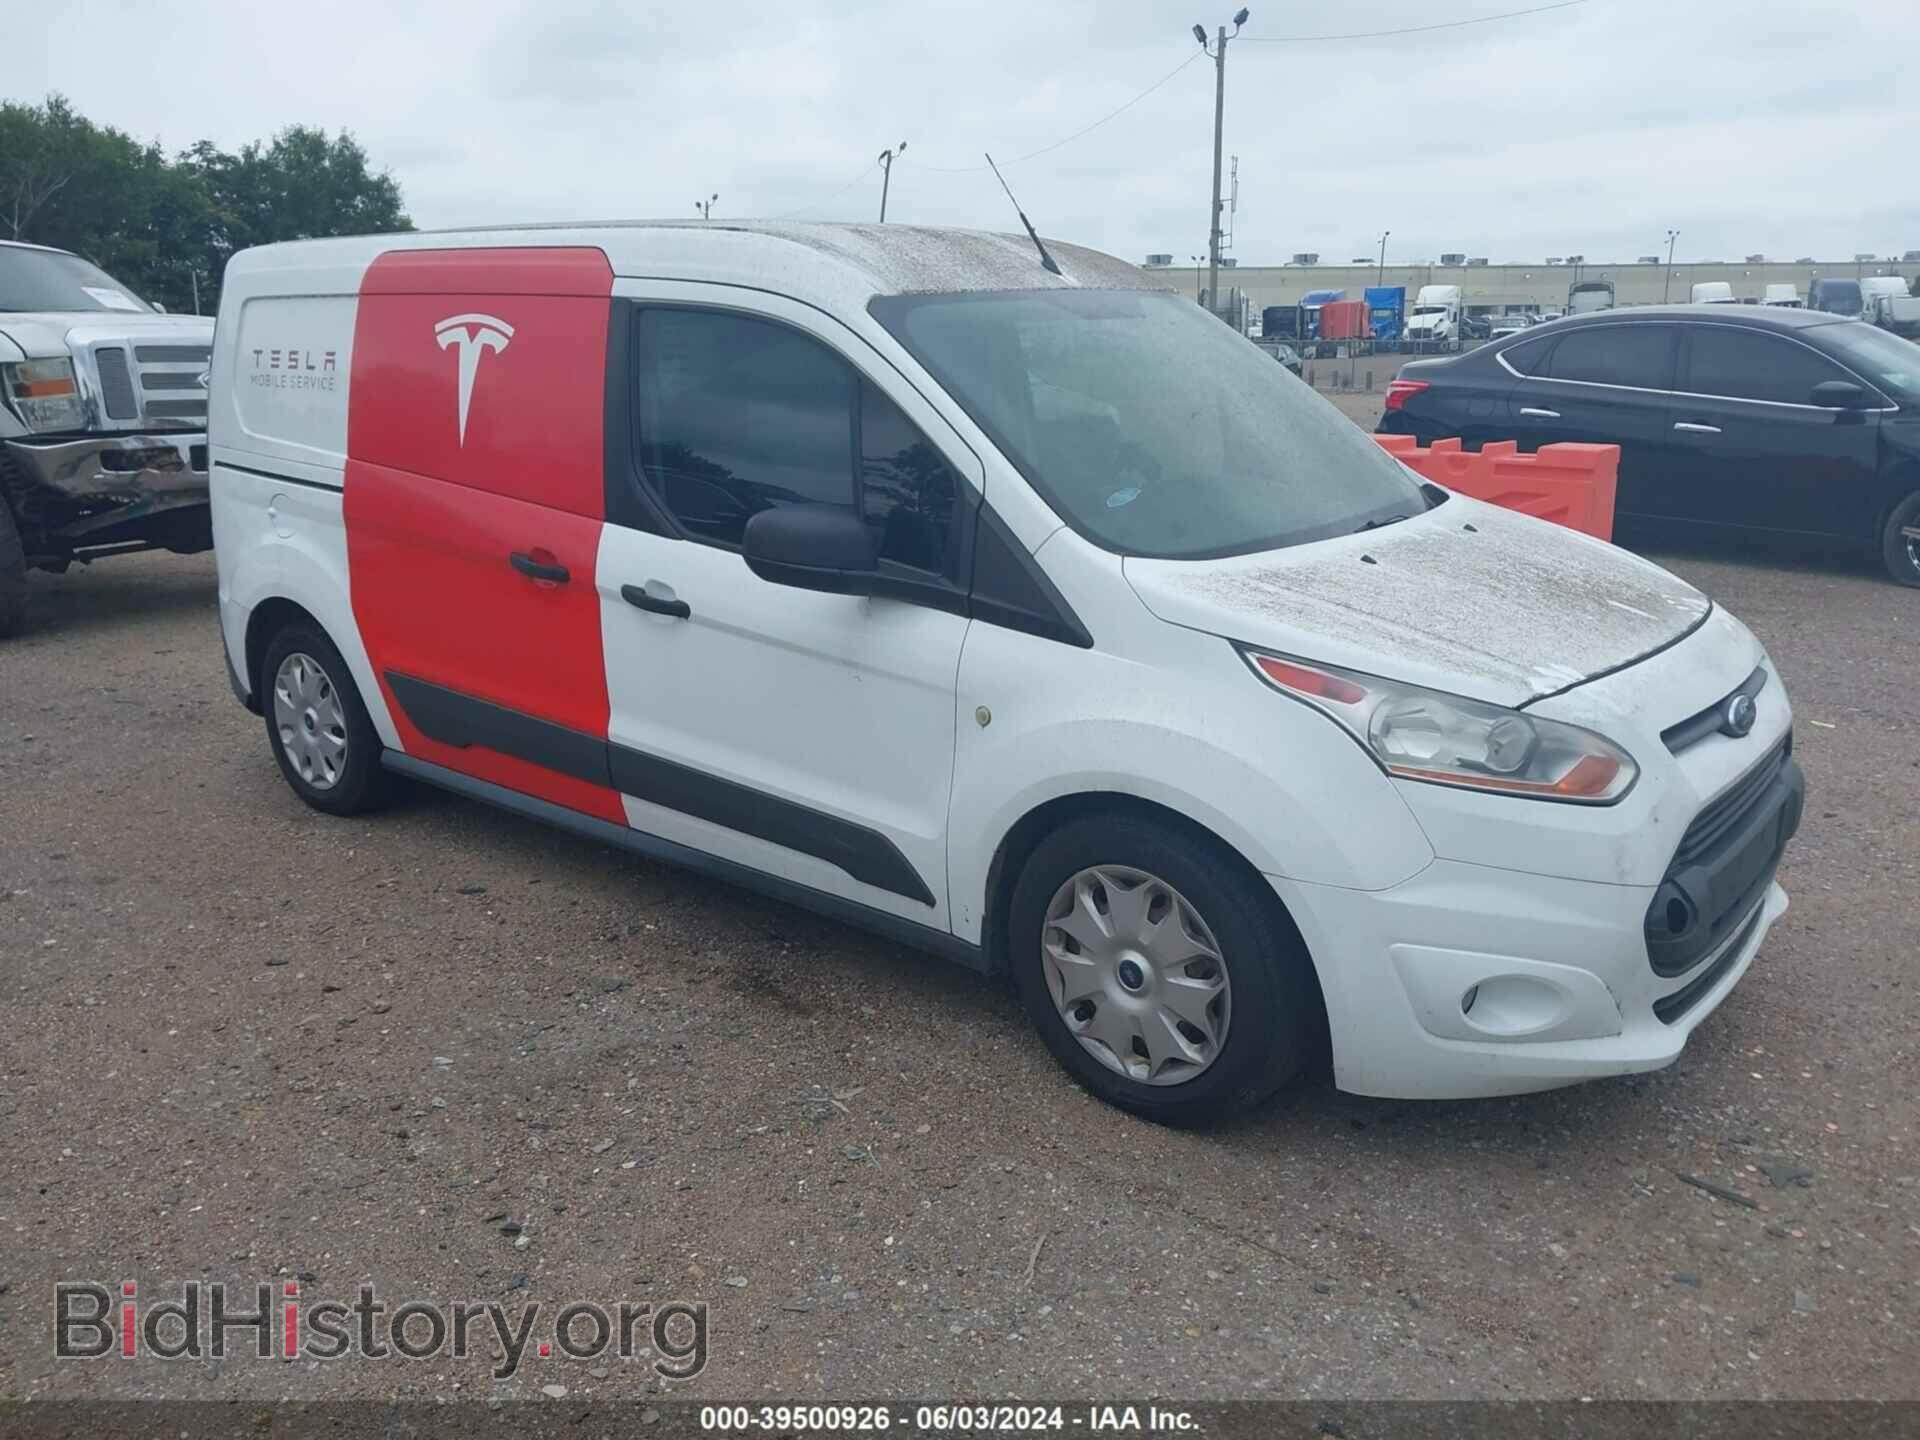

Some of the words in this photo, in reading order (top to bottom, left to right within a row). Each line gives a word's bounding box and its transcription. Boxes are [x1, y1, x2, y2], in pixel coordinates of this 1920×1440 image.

[253, 349, 336, 371] TESLA
[250, 373, 287, 389] MOBILE
[289, 374, 336, 392] SERVICE
